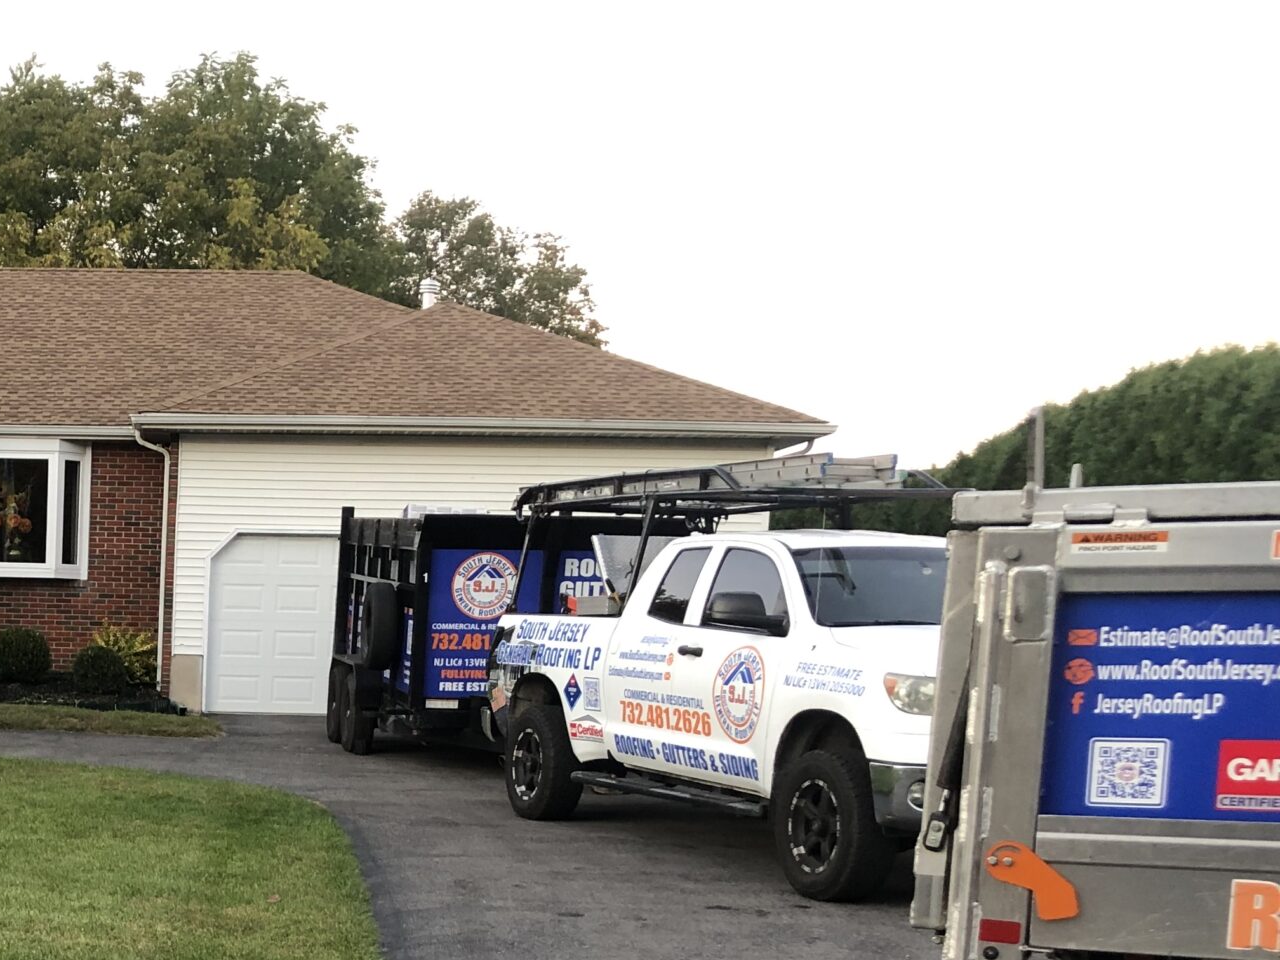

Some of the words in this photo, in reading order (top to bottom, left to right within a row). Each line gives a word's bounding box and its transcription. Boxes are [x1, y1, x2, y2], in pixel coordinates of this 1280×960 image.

[1093, 533, 1158, 543] WARNING
[423, 572, 429, 583] 1
[458, 556, 483, 578] SOUTH
[486, 555, 516, 581] JERSEY
[455, 587, 476, 615] GENERAL
[432, 622, 479, 631] COMMERCIAL
[481, 623, 487, 631] &
[517, 619, 549, 641] SOUTH
[548, 620, 591, 643] JERSEY
[433, 657, 444, 667] NJ
[445, 657, 463, 667] LIC#
[496, 640, 533, 665] GENERAL
[535, 643, 581, 670] ROOFING
[583, 646, 602, 671] LP
[718, 652, 742, 680] SOUTH
[796, 661, 818, 675] FREE
[816, 664, 863, 681] ESTIMATE
[439, 682, 464, 692] FREE
[624, 688, 660, 703] COMMERCIAL
[666, 694, 704, 709] RESIDENTIAL
[1094, 692, 1225, 719] JerseyRoofingLP
[620, 701, 712, 737] 732.481.2626
[614, 734, 656, 760] ROOFING
[661, 742, 709, 771] GUTTERS
[709, 754, 719, 772] &
[719, 752, 759, 781] SIDING
